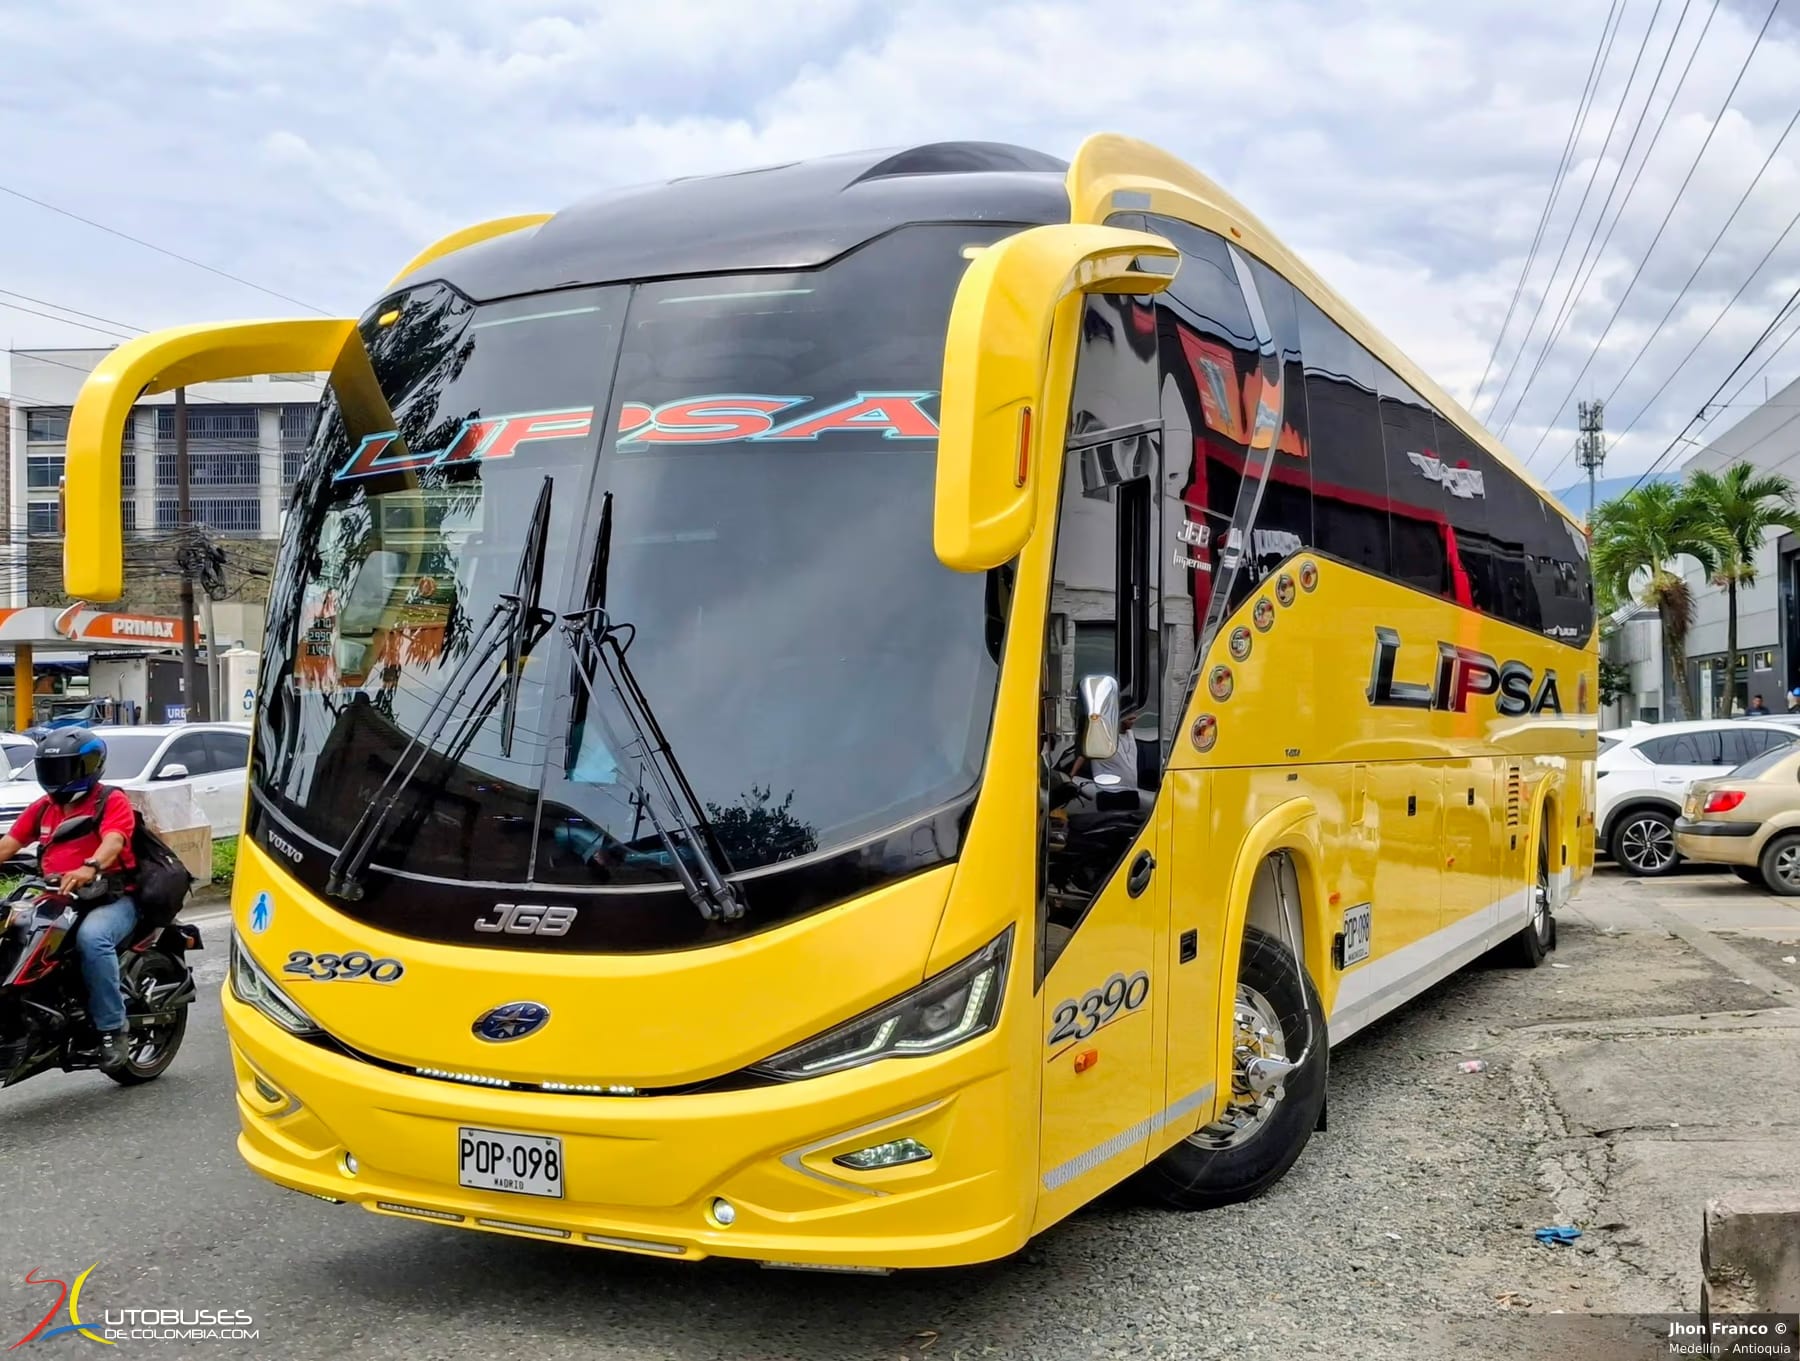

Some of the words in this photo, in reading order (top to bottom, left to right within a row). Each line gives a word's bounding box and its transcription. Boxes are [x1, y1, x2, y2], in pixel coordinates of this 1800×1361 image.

[332, 390, 941, 481] LIPSA
[1177, 519, 1210, 547] JGB
[112, 617, 174, 638] PRIMAX
[1366, 626, 1563, 718] LIPSA
[268, 829, 304, 863] VOLVO
[474, 904, 578, 936] JGB
[282, 951, 405, 982] 2390
[1047, 970, 1150, 1046] 2390
[494, 1178, 524, 1190] MADRID
